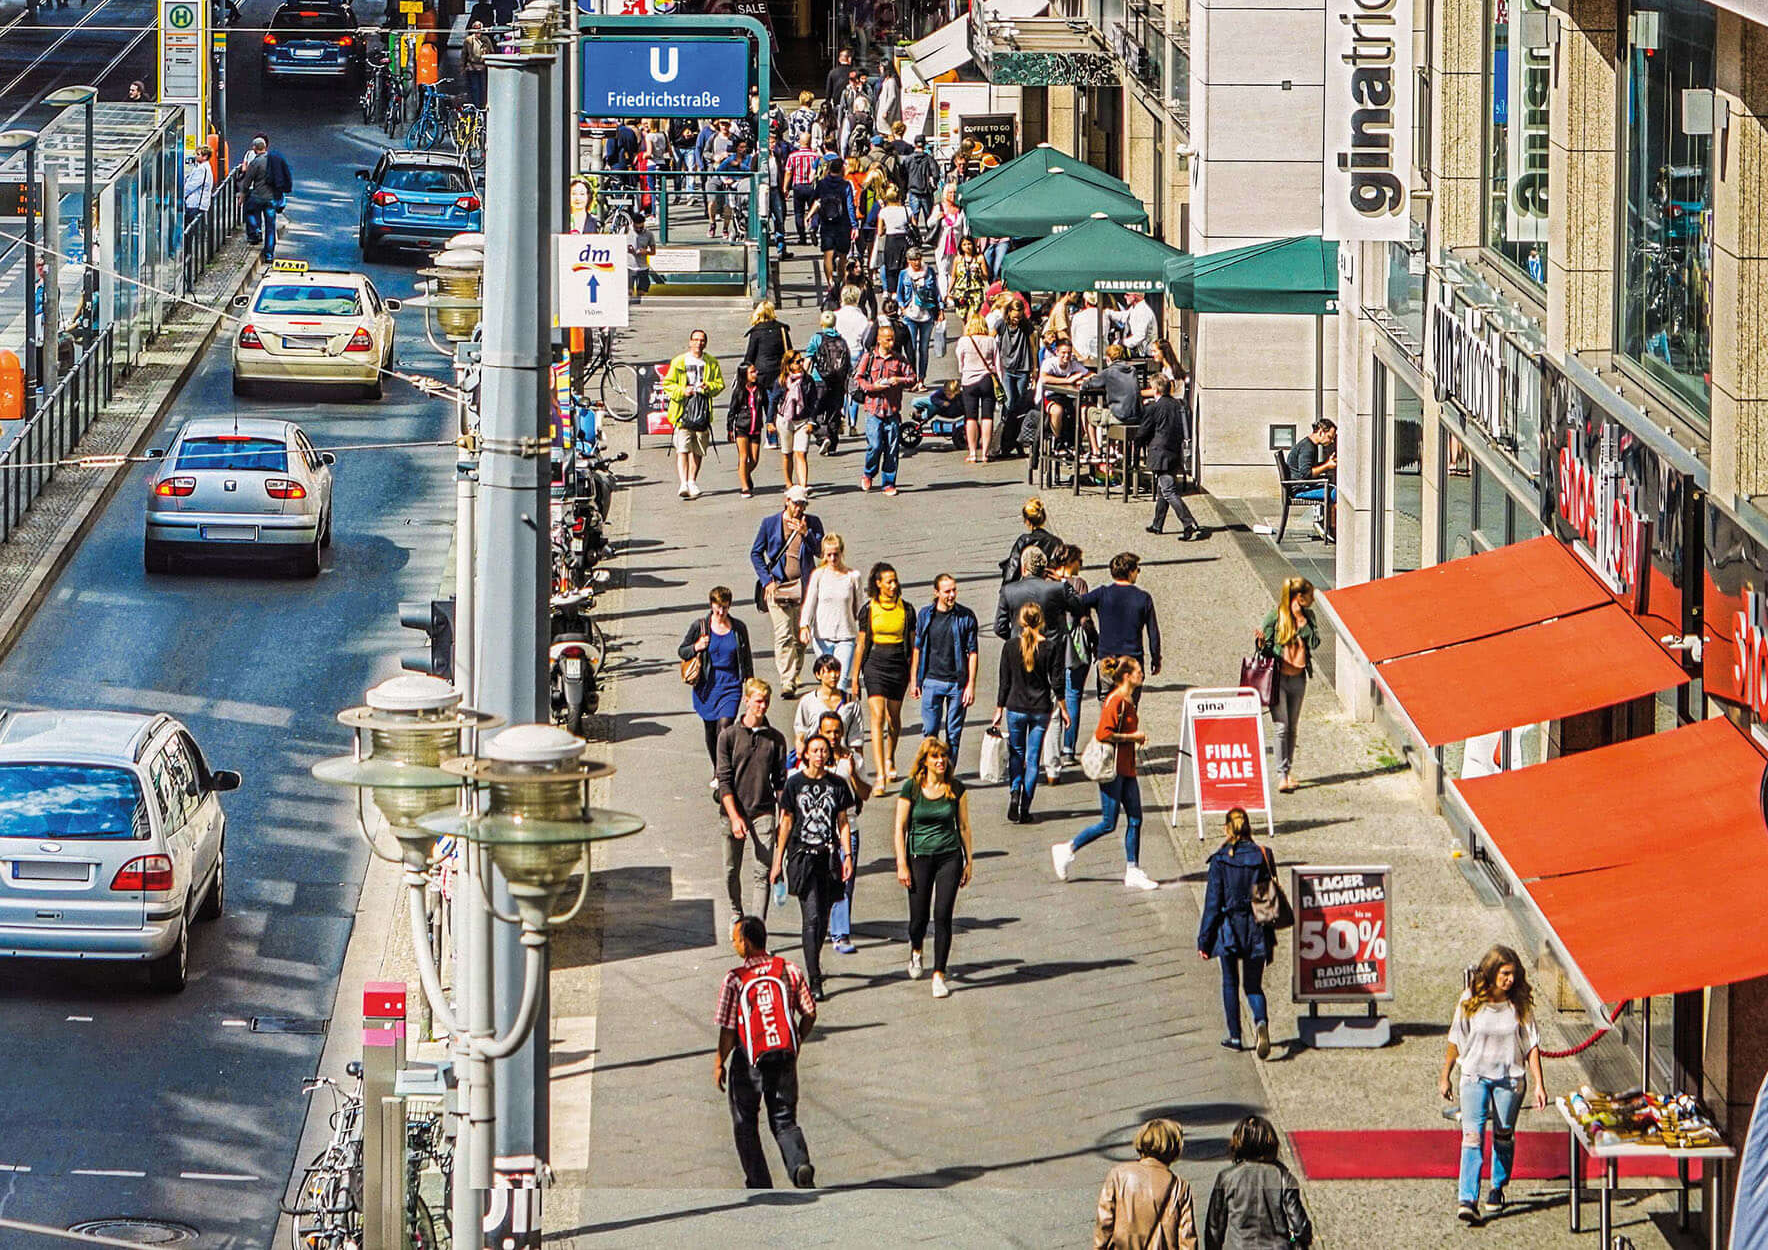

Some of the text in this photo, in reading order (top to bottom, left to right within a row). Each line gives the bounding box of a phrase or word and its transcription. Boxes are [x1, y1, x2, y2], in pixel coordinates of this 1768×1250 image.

[737, 3, 768, 15] SALE
[650, 47, 678, 83] U
[607, 91, 721, 108] Friedrichstraße
[579, 244, 610, 263] dm
[1094, 280, 1153, 290] STARBUCKS
[1205, 743, 1252, 759] FINAL
[1206, 761, 1254, 779] SALE
[1313, 874, 1364, 892] LAGER
[1302, 886, 1385, 909] RÄUMUNG
[1300, 920, 1387, 960] 50%
[1317, 962, 1371, 979] RADIKAL
[1314, 972, 1378, 989] REDUZIERT
[756, 981, 782, 1047] EXTREM
